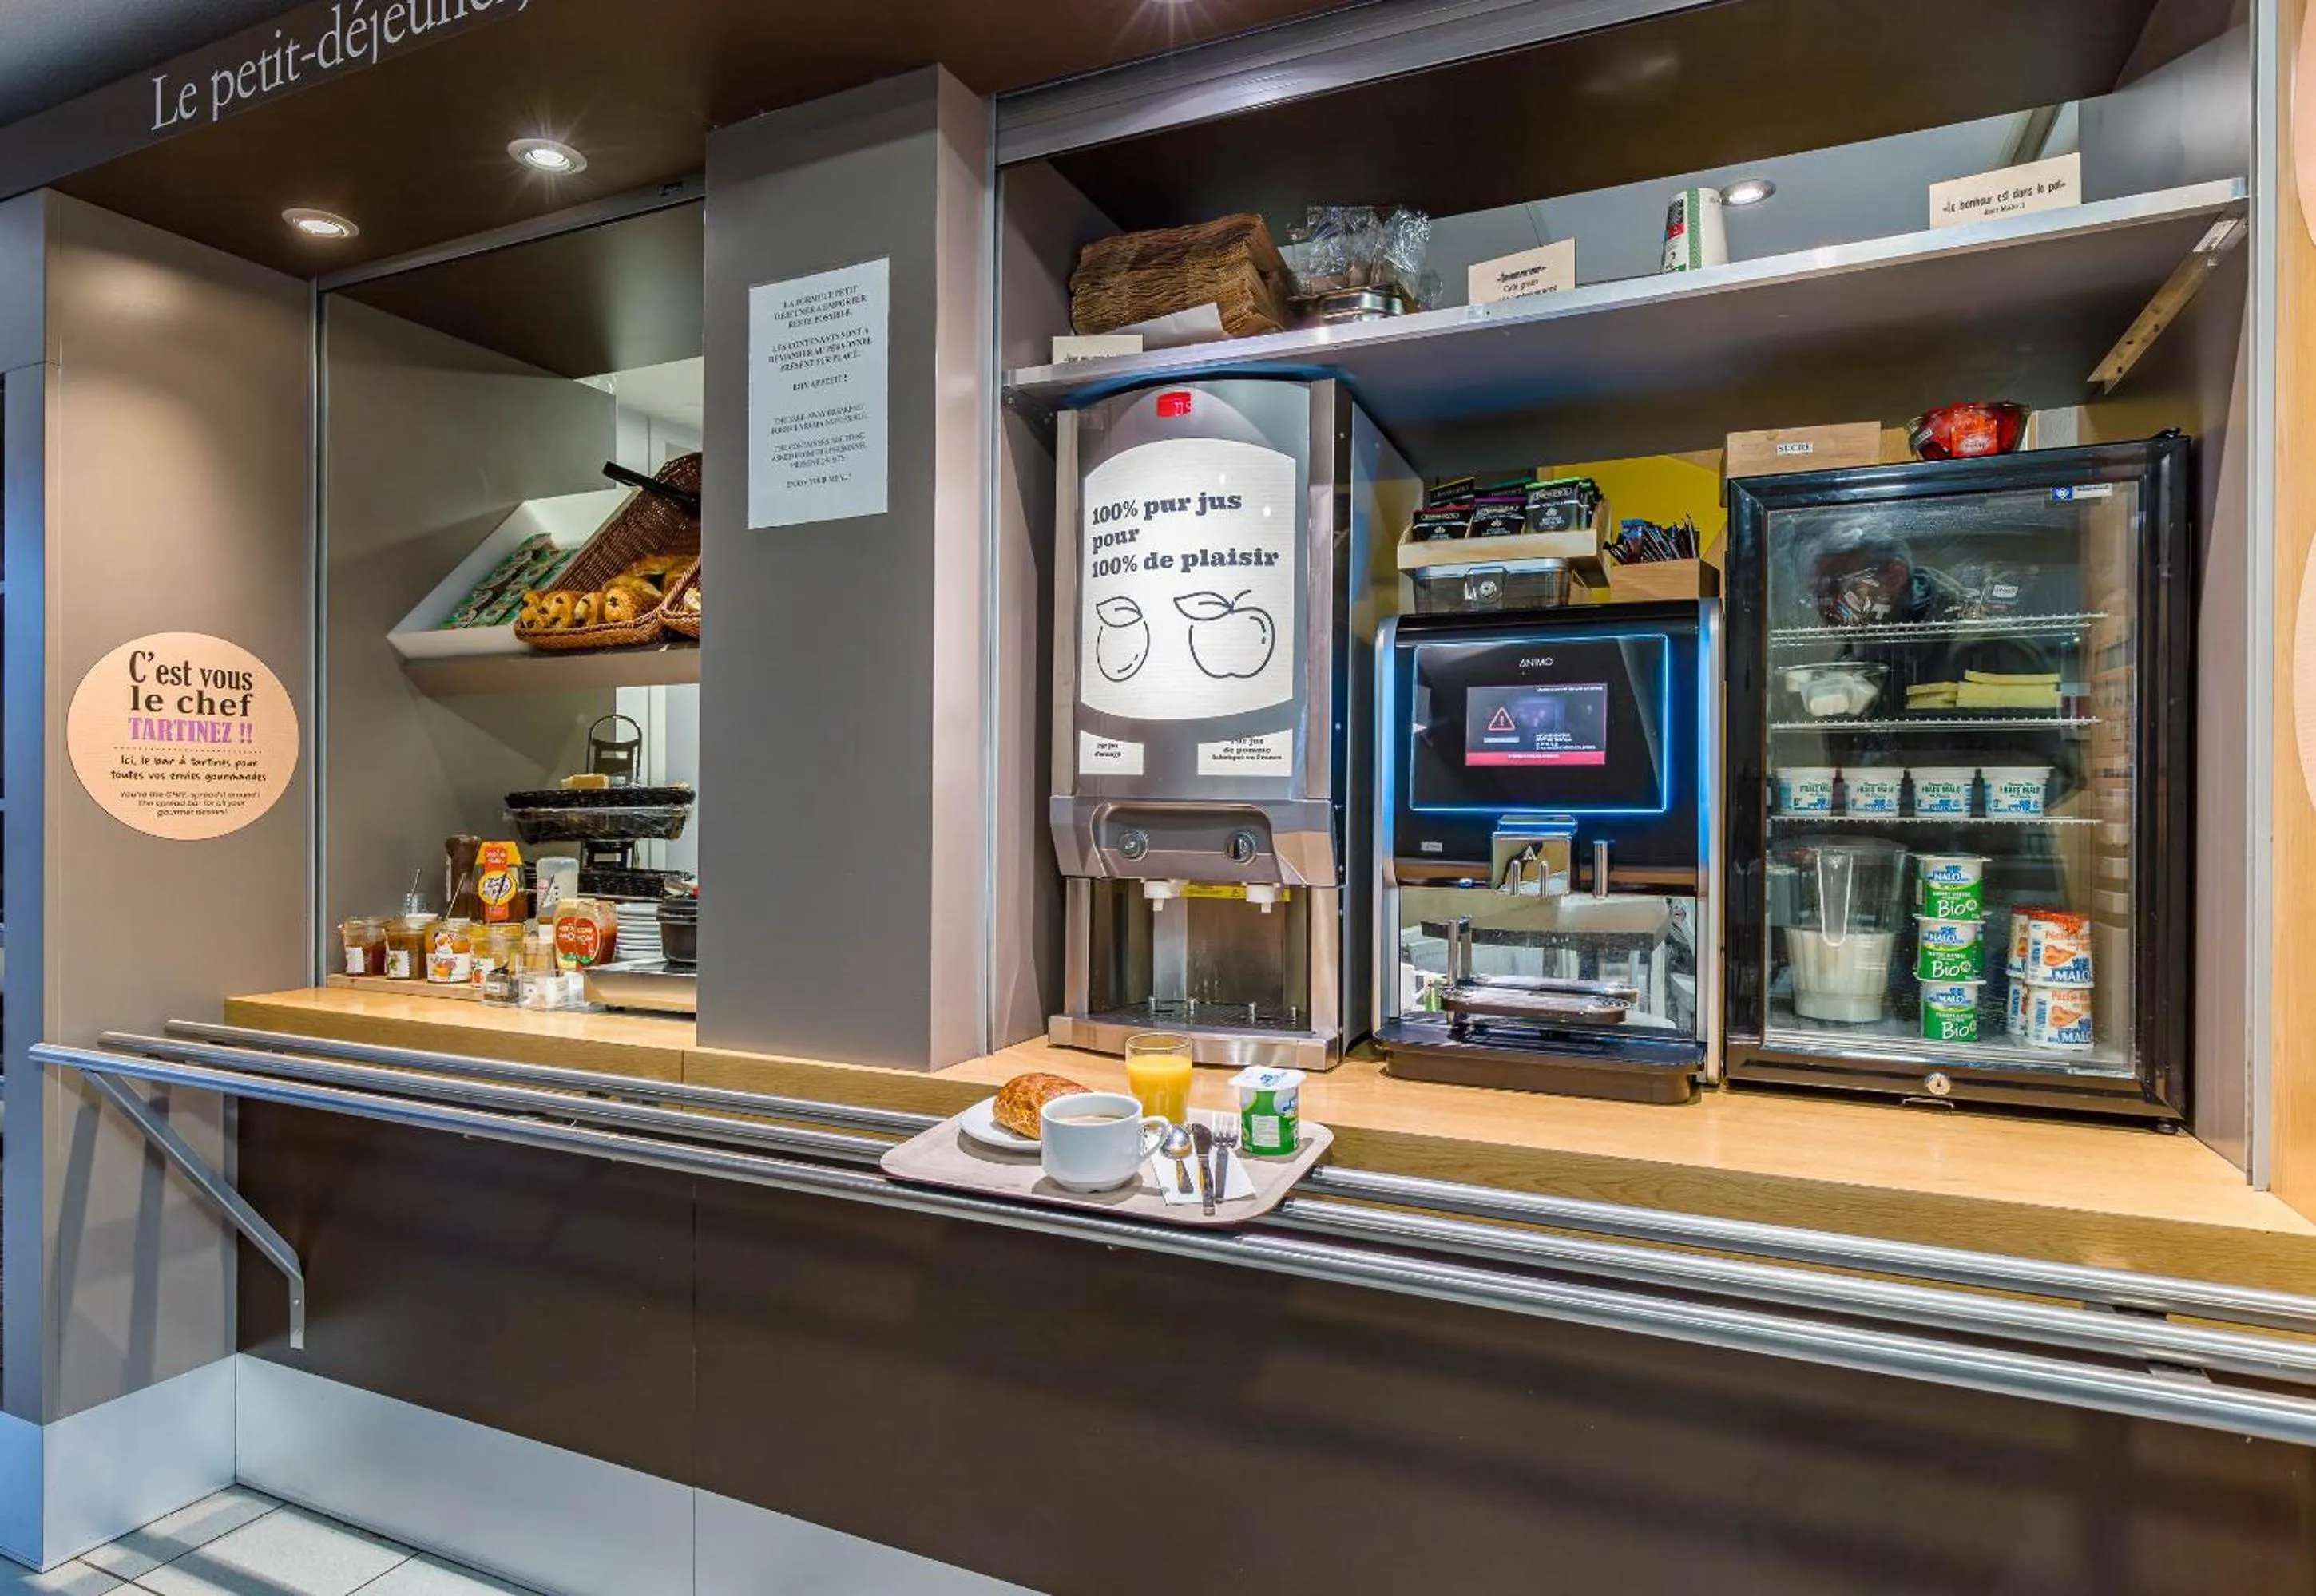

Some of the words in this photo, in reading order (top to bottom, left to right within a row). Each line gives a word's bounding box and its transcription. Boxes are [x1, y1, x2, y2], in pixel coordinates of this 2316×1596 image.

[150, 74, 198, 131] Le
[210, 0, 529, 122] petit-déjeun,
[1092, 499, 1139, 525] 100%
[1144, 496, 1192, 521] pur
[1196, 491, 1243, 517] jus
[1092, 526, 1140, 554] pour
[1092, 554, 1138, 578] 100%
[1144, 549, 1174, 571] de
[1180, 547, 1279, 573] plaisir
[129, 651, 192, 687] C'est
[200, 667, 253, 691] vous
[130, 685, 165, 712] le
[176, 688, 254, 718] chef
[128, 717, 233, 744] TARTINEZ
[239, 722, 253, 745] !!
[110, 770, 145, 780] toutes
[149, 771, 166, 780] vos
[170, 770, 201, 780] envies
[204, 771, 267, 782] gourmandes
[121, 754, 137, 766] Ici,
[141, 755, 150, 766] le
[154, 755, 175, 766] bar
[178, 755, 186, 766] à
[191, 757, 231, 767] tartines
[235, 758, 258, 770] pour
[1937, 899, 1965, 917] Bio
[1931, 960, 1960, 978] Bio
[1941, 1021, 1969, 1040] Bio
